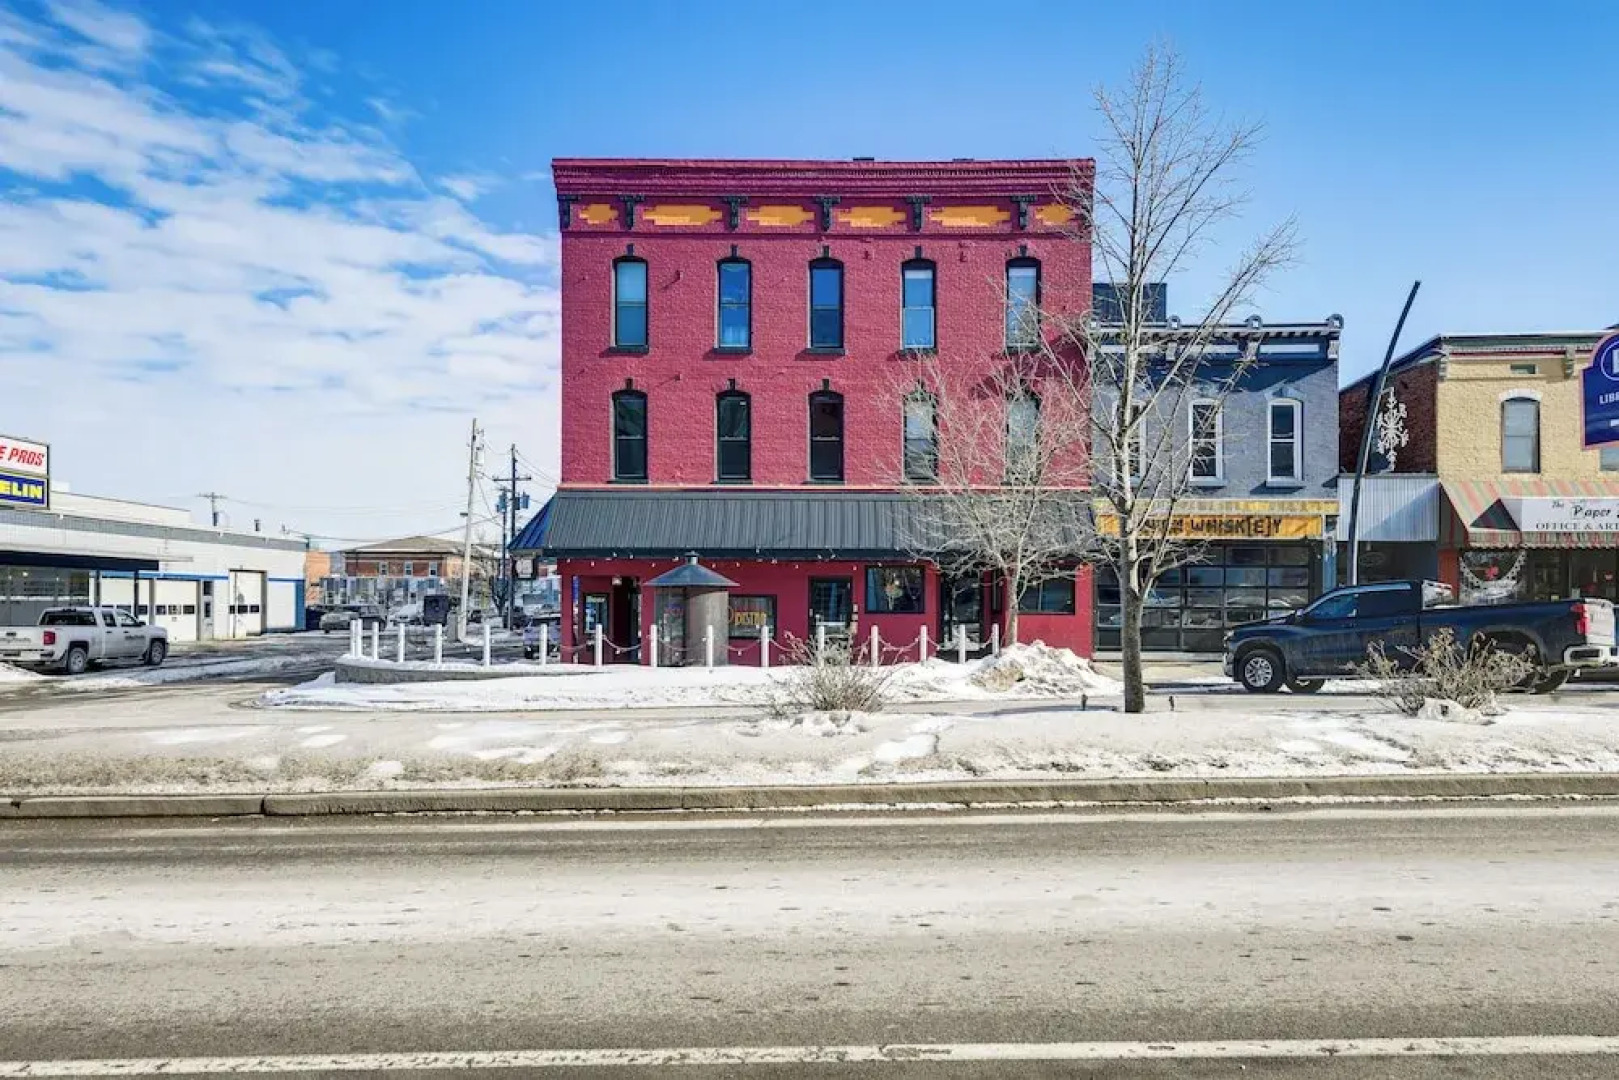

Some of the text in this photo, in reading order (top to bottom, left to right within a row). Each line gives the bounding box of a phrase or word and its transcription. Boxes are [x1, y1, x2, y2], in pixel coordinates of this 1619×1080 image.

[8, 448, 45, 466] PROS
[1573, 504, 1611, 519] Paper
[1536, 522, 1581, 530] OFFICE
[1585, 522, 1593, 530] &
